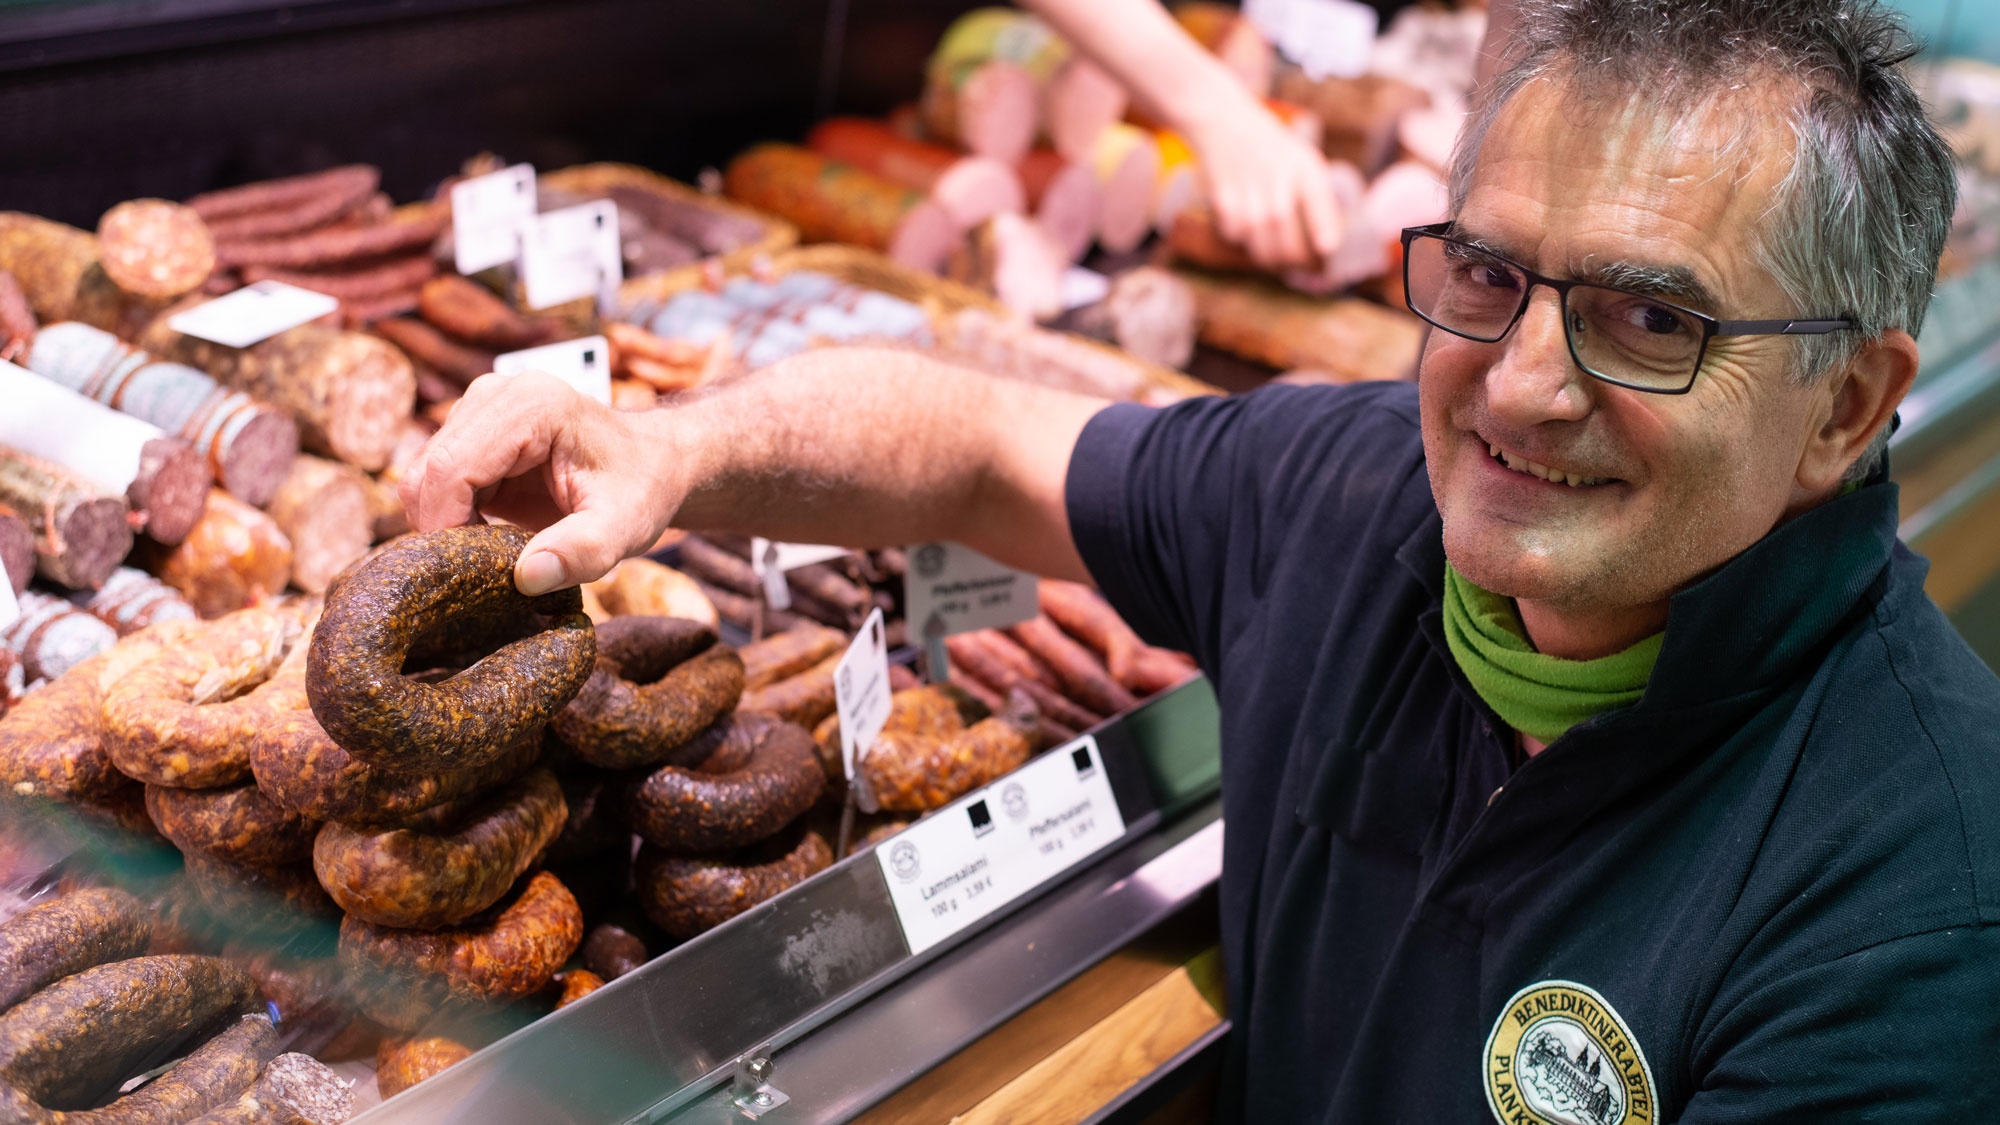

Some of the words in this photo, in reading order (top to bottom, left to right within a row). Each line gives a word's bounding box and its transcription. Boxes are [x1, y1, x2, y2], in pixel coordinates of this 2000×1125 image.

[1029, 797, 1092, 839] Pfeffersalami
[921, 855, 988, 901] Lammsalami
[931, 899, 950, 918] 100
[1513, 993, 1648, 1121] BENEDIKTINERABTEI
